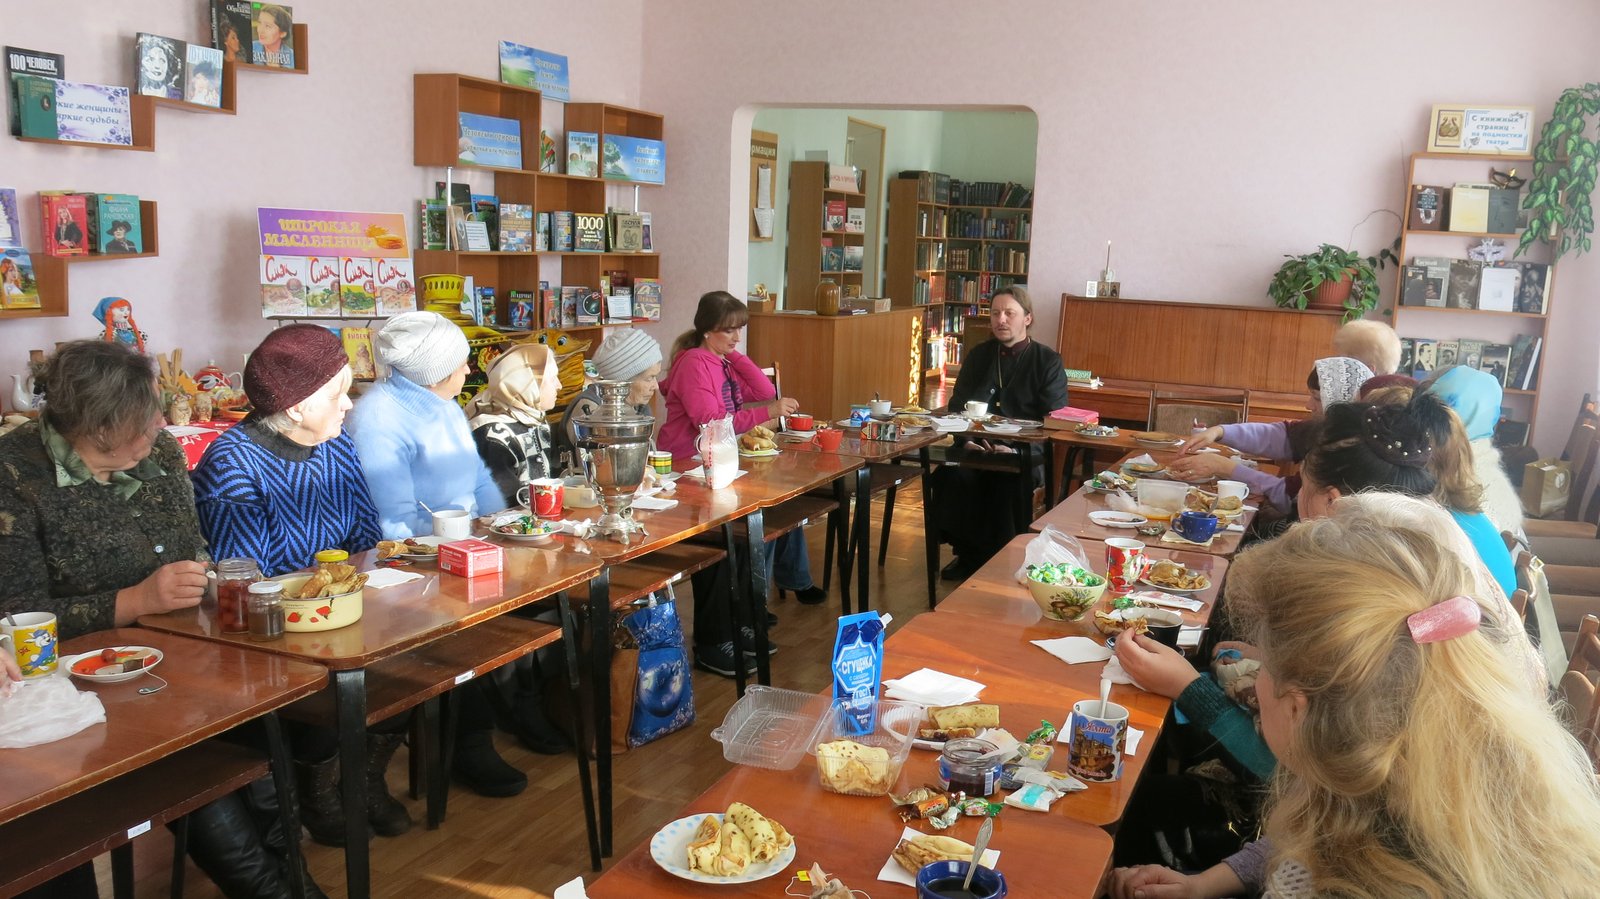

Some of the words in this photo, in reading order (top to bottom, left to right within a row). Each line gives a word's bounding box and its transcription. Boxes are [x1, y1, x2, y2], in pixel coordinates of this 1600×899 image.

[9, 53, 26, 71] 100
[76, 103, 122, 113] женщины
[85, 115, 119, 125] судьбы
[278, 218, 362, 234] ШИРОКАЯ
[577, 216, 604, 231] 1000
[263, 233, 378, 251] МАСЛЕНИЦА
